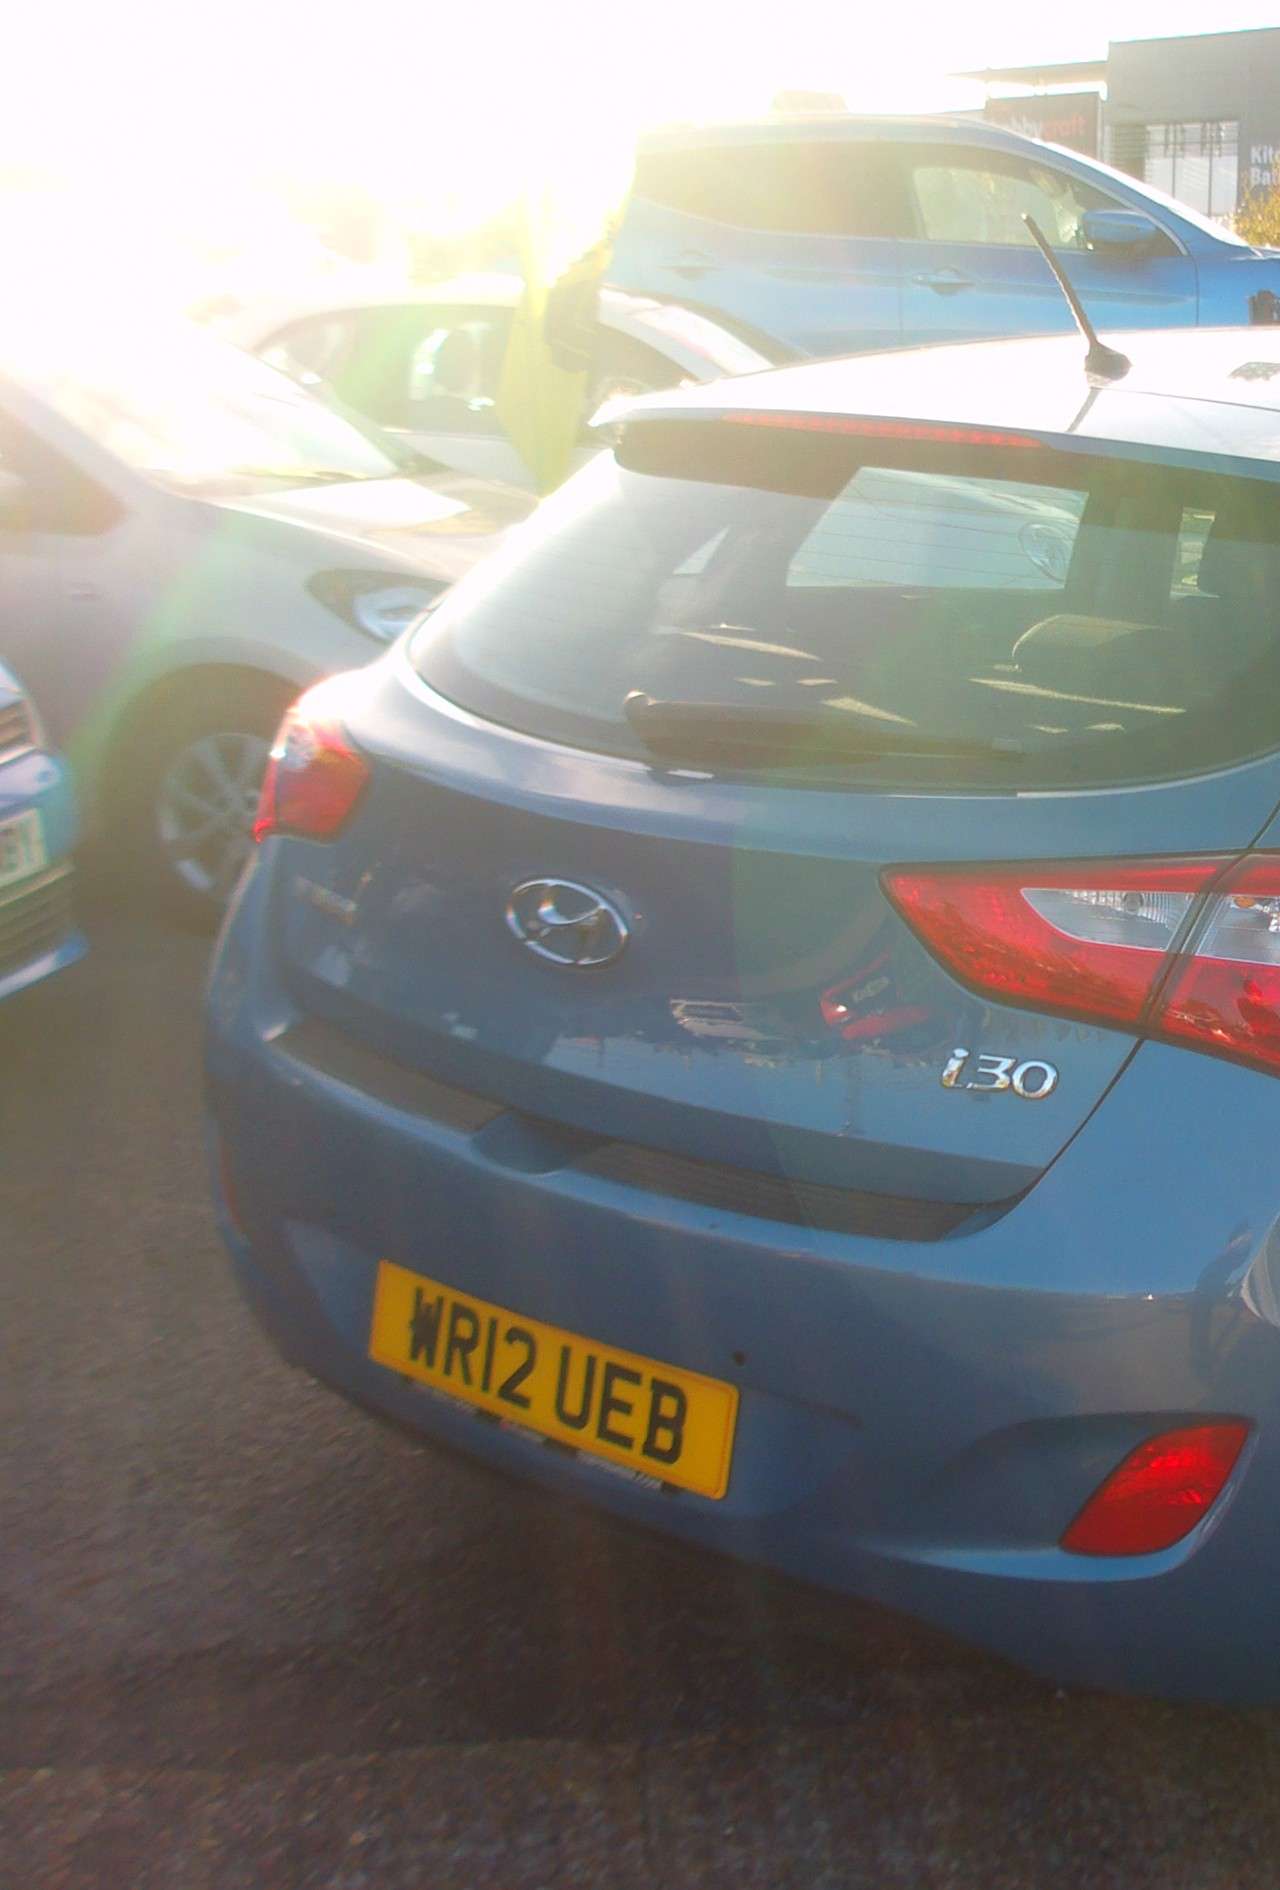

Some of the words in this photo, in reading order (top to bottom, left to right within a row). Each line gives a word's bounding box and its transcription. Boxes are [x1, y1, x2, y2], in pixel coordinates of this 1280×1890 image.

[941, 1047, 1058, 1100] i30
[410, 1286, 538, 1409] WR12
[554, 1346, 688, 1466] UEB
